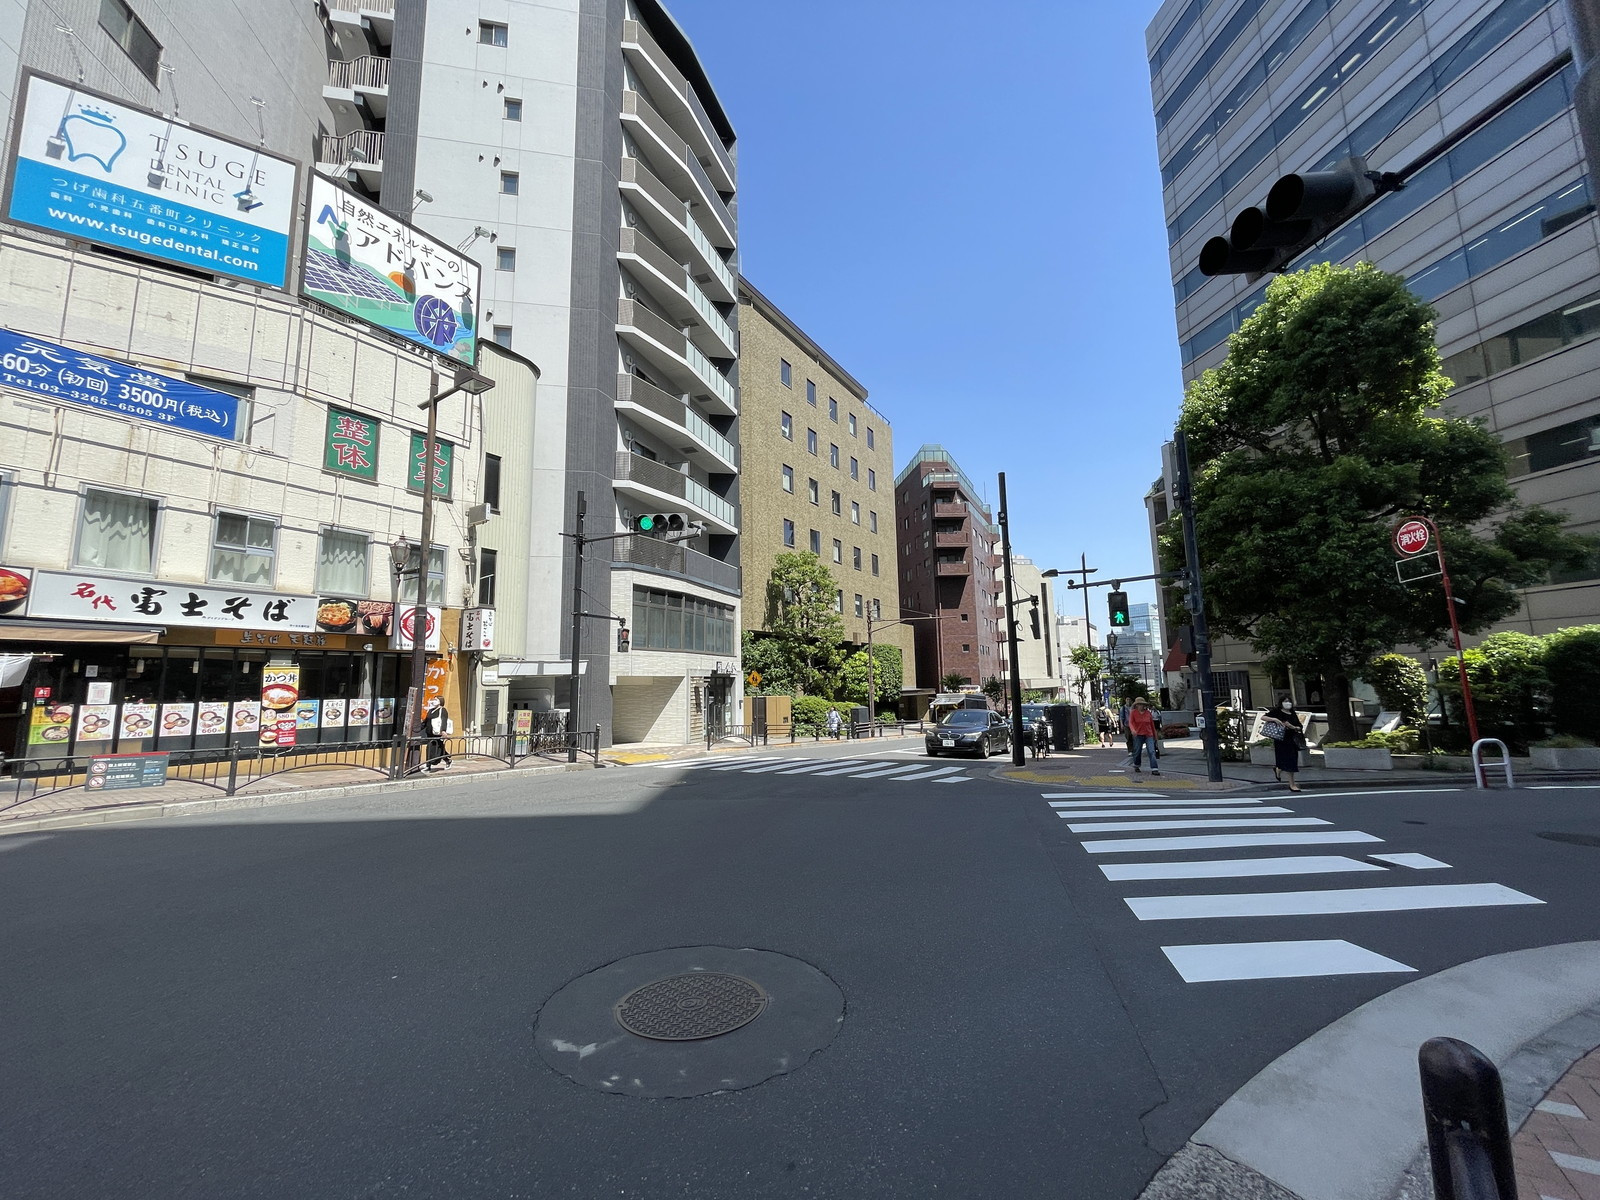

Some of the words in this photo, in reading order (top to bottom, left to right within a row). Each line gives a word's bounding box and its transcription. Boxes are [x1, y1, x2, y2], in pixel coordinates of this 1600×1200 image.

[149, 133, 266, 186] TSUGE
[150, 158, 226, 191] DENTAL
[50, 191, 73, 203] 歯科
[147, 171, 225, 205] CLINIC
[52, 177, 262, 242] つげ歯科五番町クリニック
[48, 207, 259, 271] www.tsugedental.com
[342, 199, 460, 273] 自然エネルギーの
[356, 227, 474, 304] アドバンス
[158, 412, 176, 422] 3F
[332, 416, 371, 469] 整体
[1399, 529, 1426, 547] 消火栓
[70, 582, 117, 611] 名代
[131, 587, 296, 622] 富士そば
[265, 674, 297, 683] かつ丼
